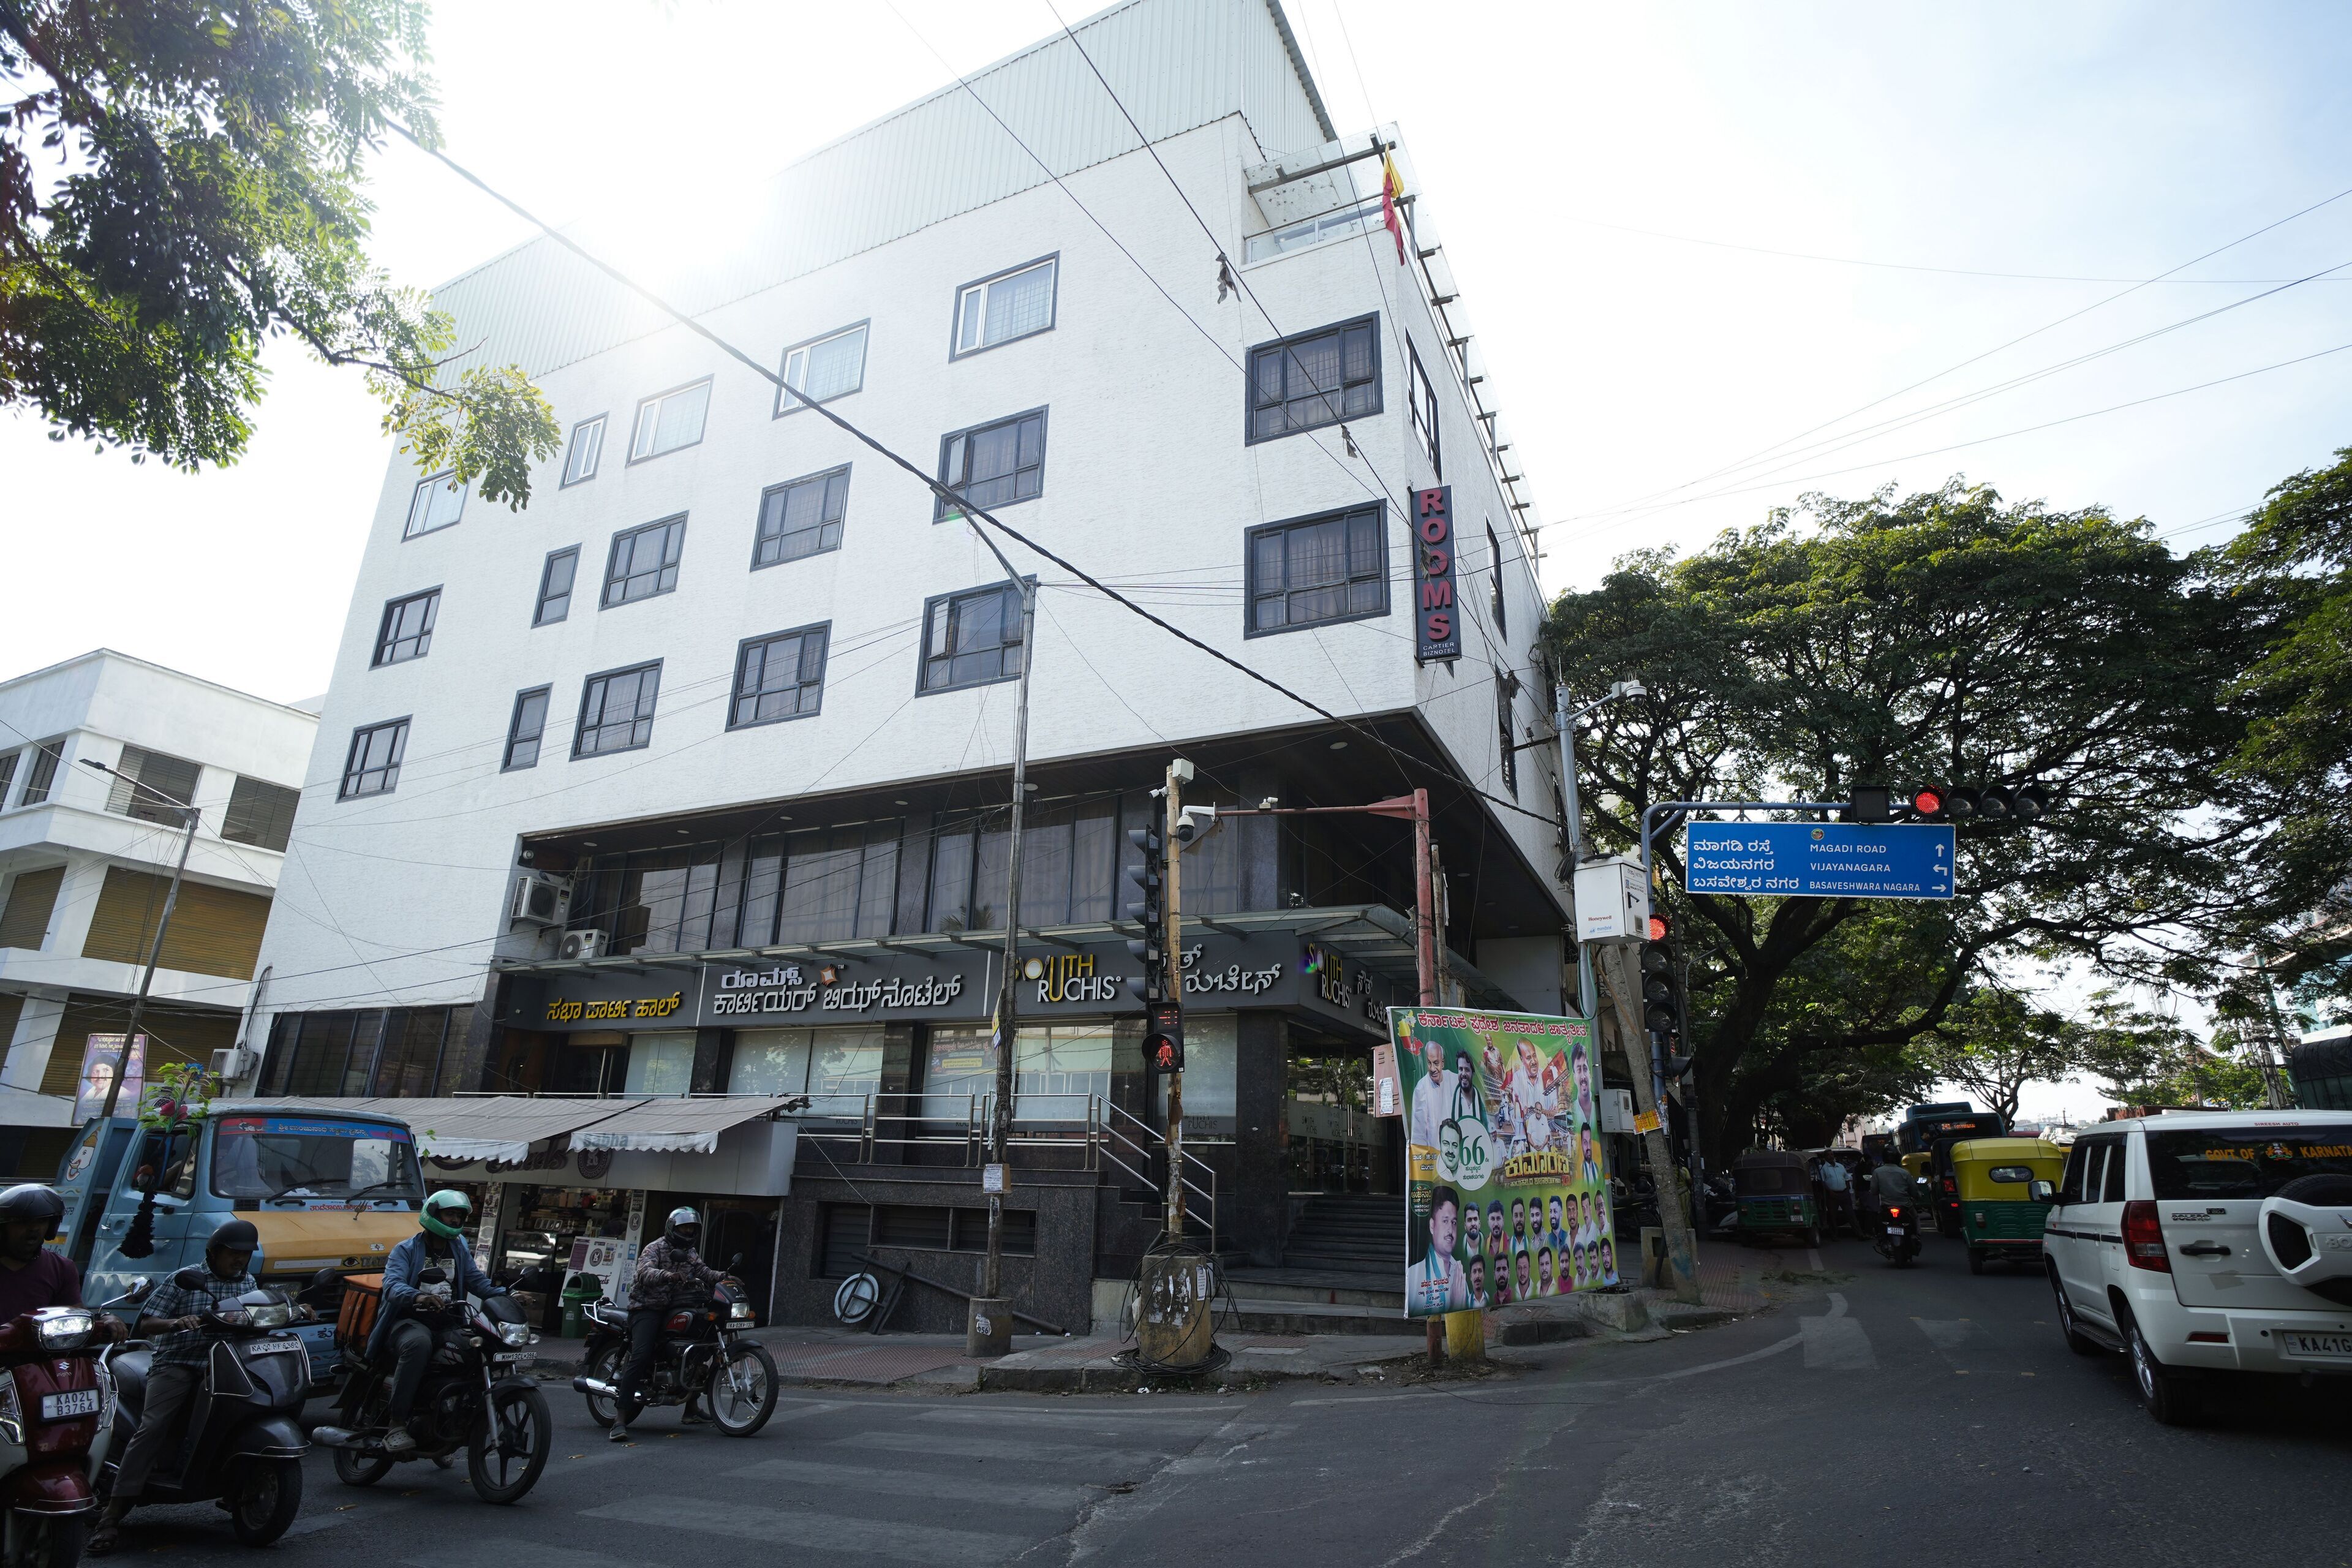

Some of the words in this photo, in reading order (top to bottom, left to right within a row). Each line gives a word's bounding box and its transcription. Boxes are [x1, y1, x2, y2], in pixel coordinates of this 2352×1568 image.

[1420, 489, 1452, 640] ROOMS
[1423, 642, 1455, 650] CARTIER
[1423, 648, 1455, 657] BIZNOTEL
[1693, 839, 1743, 851] ಮಾಗಡಿ
[1748, 840, 1774, 854] ರಸ್ತೆ
[1810, 844, 1853, 853] MAGADI
[1856, 845, 1887, 853] ROAD
[1693, 858, 1774, 870] ವಿಜಯನಗರ
[1810, 863, 1891, 872] VIJAYANAGARA
[1693, 876, 1762, 891] ಬಸವೇಶ್ವರ
[1765, 877, 1800, 889] ನಗರ
[1809, 882, 1881, 891] BASAVESHWARA
[1883, 883, 1920, 892] NAGARA
[1037, 976, 1117, 1003] RUCHIS
[546, 998, 581, 1020] ಸಭಾ
[586, 999, 631, 1019] ಪಾರ್ಟಿ
[635, 992, 681, 1017] ಹಾಲ್
[1417, 1010, 1468, 1029] ಕರ್ನಾಟಕ
[1469, 1014, 1499, 1035] ಪ್ರದೇಶ
[1502, 1019, 1546, 1035] ಜನತಾದಳ
[1460, 1135, 1485, 1166] 66
[2206, 1149, 2239, 1161] GOVT.
[2240, 1148, 2255, 1159] OF
[2172, 1213, 2211, 1221] BOLERO
[57, 1391, 92, 1405] KA02L
[57, 1402, 92, 1415] B3764
